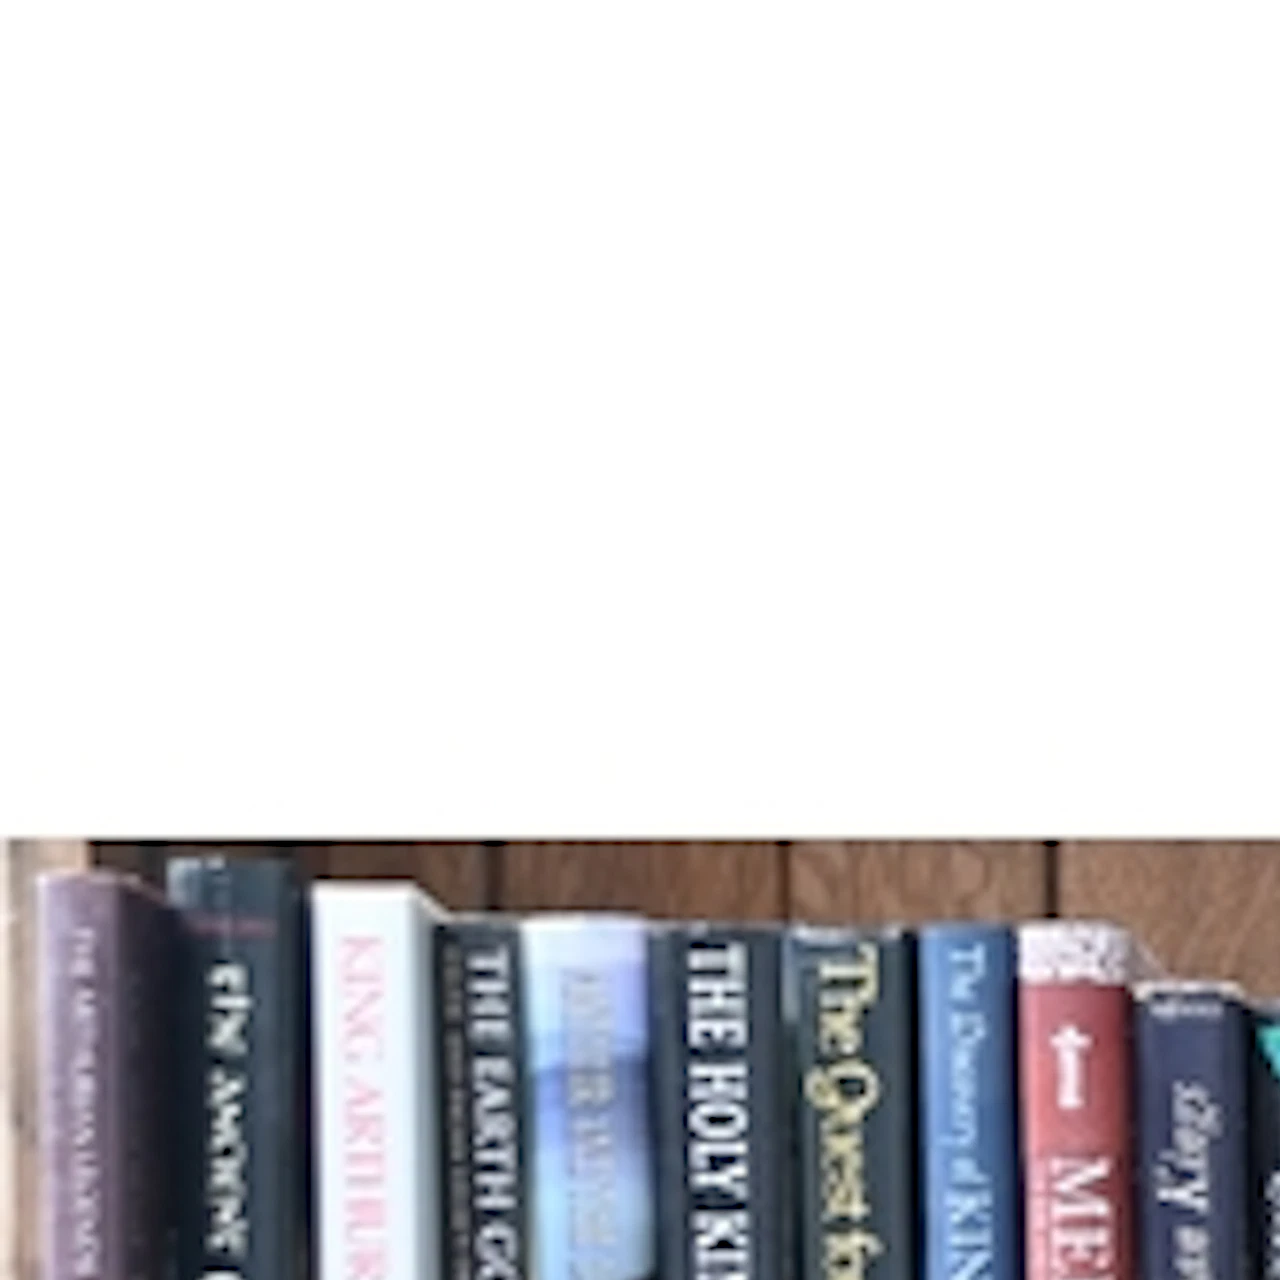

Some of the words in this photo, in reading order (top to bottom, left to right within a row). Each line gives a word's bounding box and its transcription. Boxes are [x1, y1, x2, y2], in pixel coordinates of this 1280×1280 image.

[341, 935, 387, 1064] KING
[468, 944, 510, 1040] THE
[687, 943, 750, 1044] THE
[820, 943, 884, 1054] The
[948, 943, 987, 1000] The
[471, 1054, 516, 1210] EARTH
[690, 1062, 752, 1198] HOLY
[807, 1060, 882, 1220] Quest
[939, 1009, 987, 1150] Discovery
[950, 1156, 990, 1187] of
[1155, 1081, 1225, 1210] Kings
